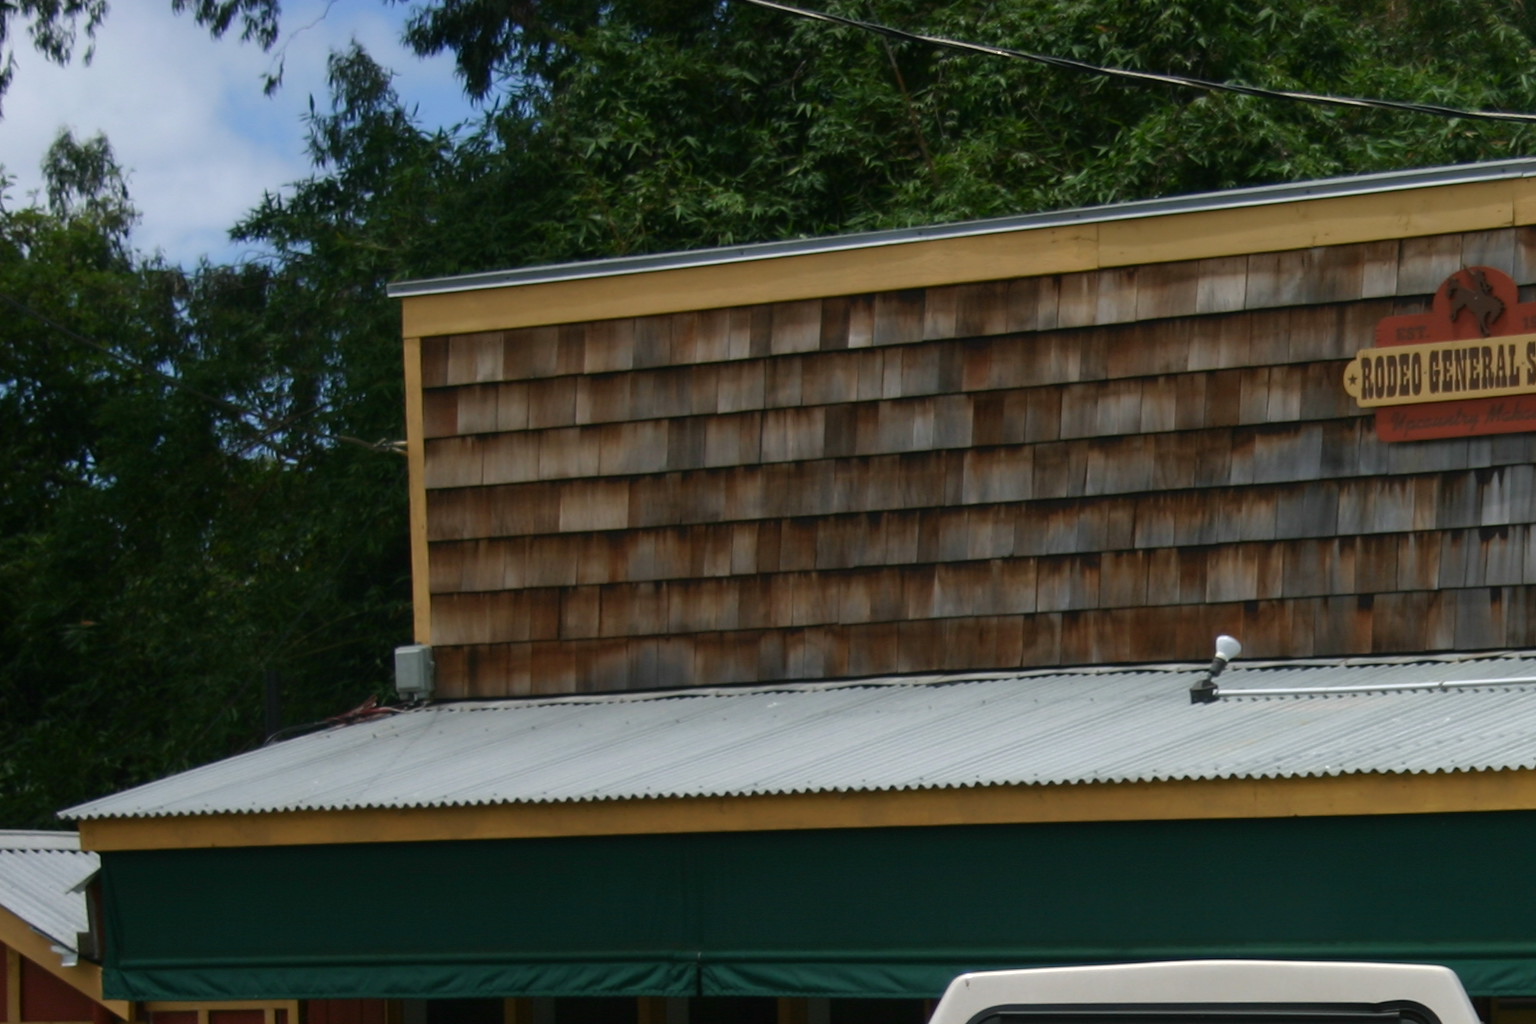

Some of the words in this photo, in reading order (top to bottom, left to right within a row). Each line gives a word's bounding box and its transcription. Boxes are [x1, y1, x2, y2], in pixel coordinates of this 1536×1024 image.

[1395, 325, 1430, 341] EST.
[1361, 351, 1422, 400] RODEO
[1429, 344, 1520, 394] GENERAL
